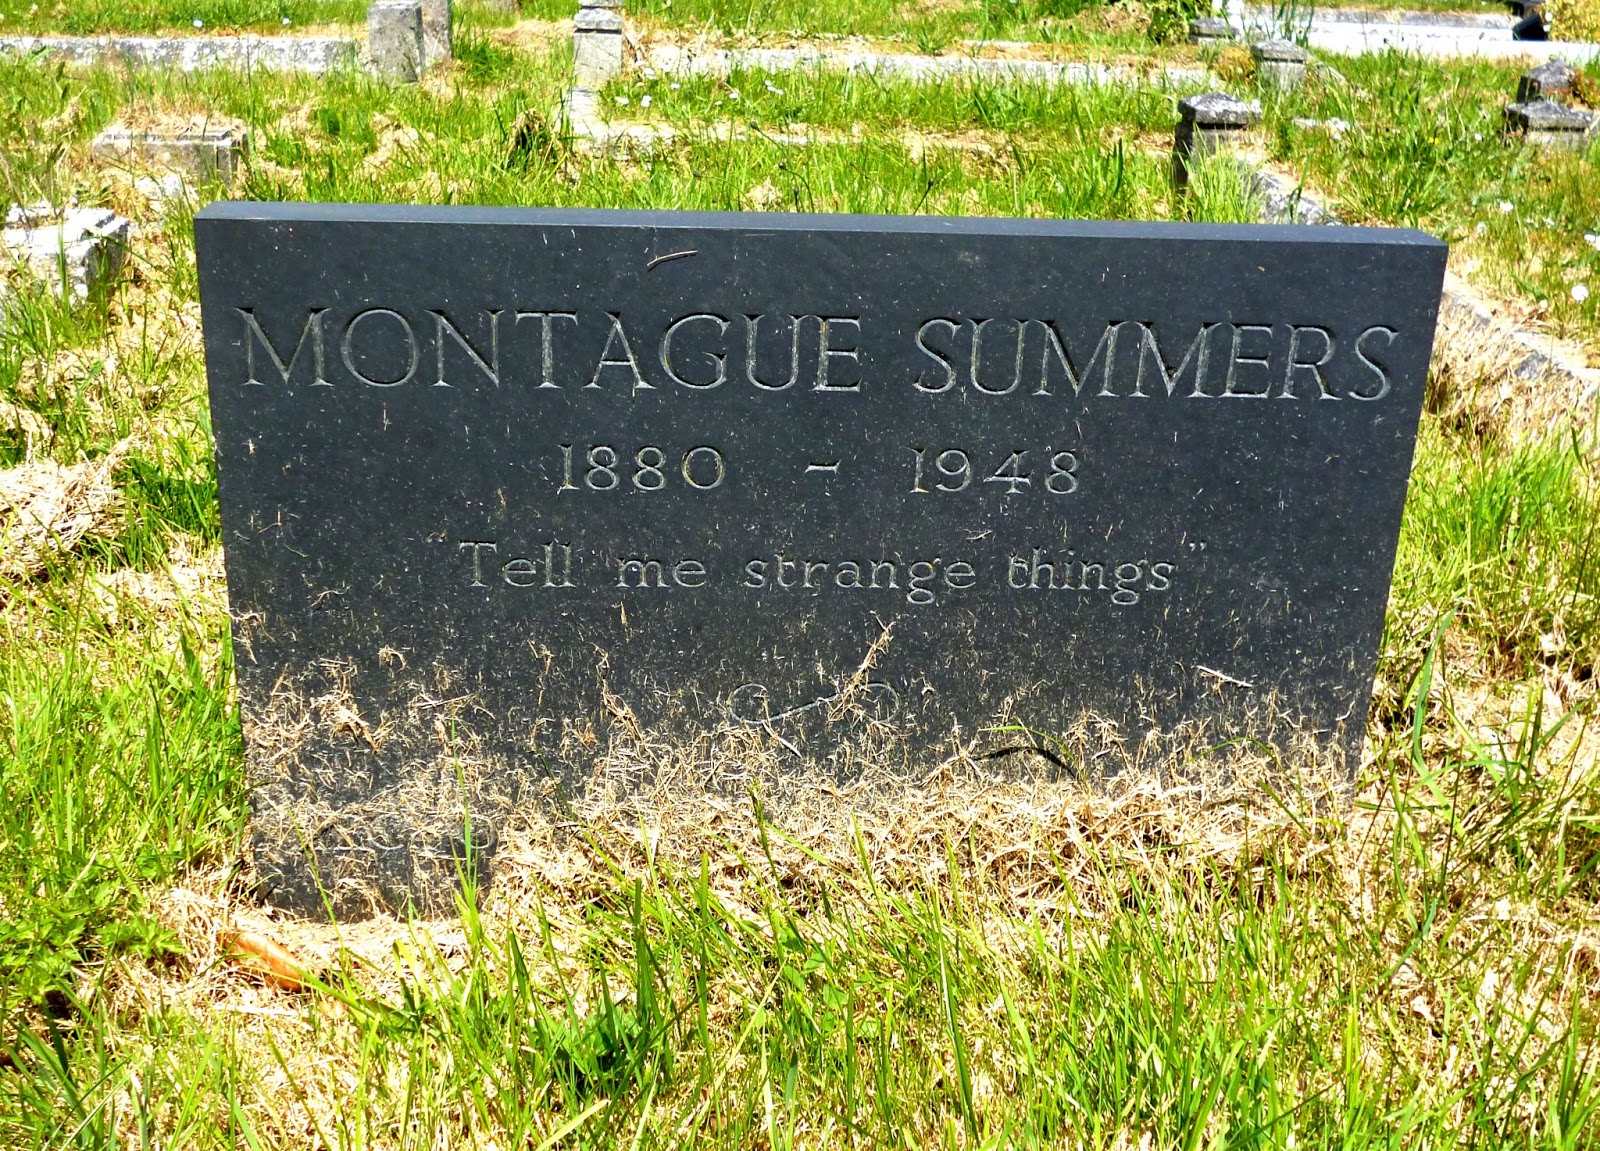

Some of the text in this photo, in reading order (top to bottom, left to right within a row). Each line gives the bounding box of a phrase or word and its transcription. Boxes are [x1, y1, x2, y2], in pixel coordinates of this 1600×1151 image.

[234, 305, 1400, 402] MONTAGUE SUMMERS
[557, 442, 727, 493] 1880
[908, 447, 1081, 496] 1948
[615, 556, 708, 589] me
[743, 550, 978, 606] strange
